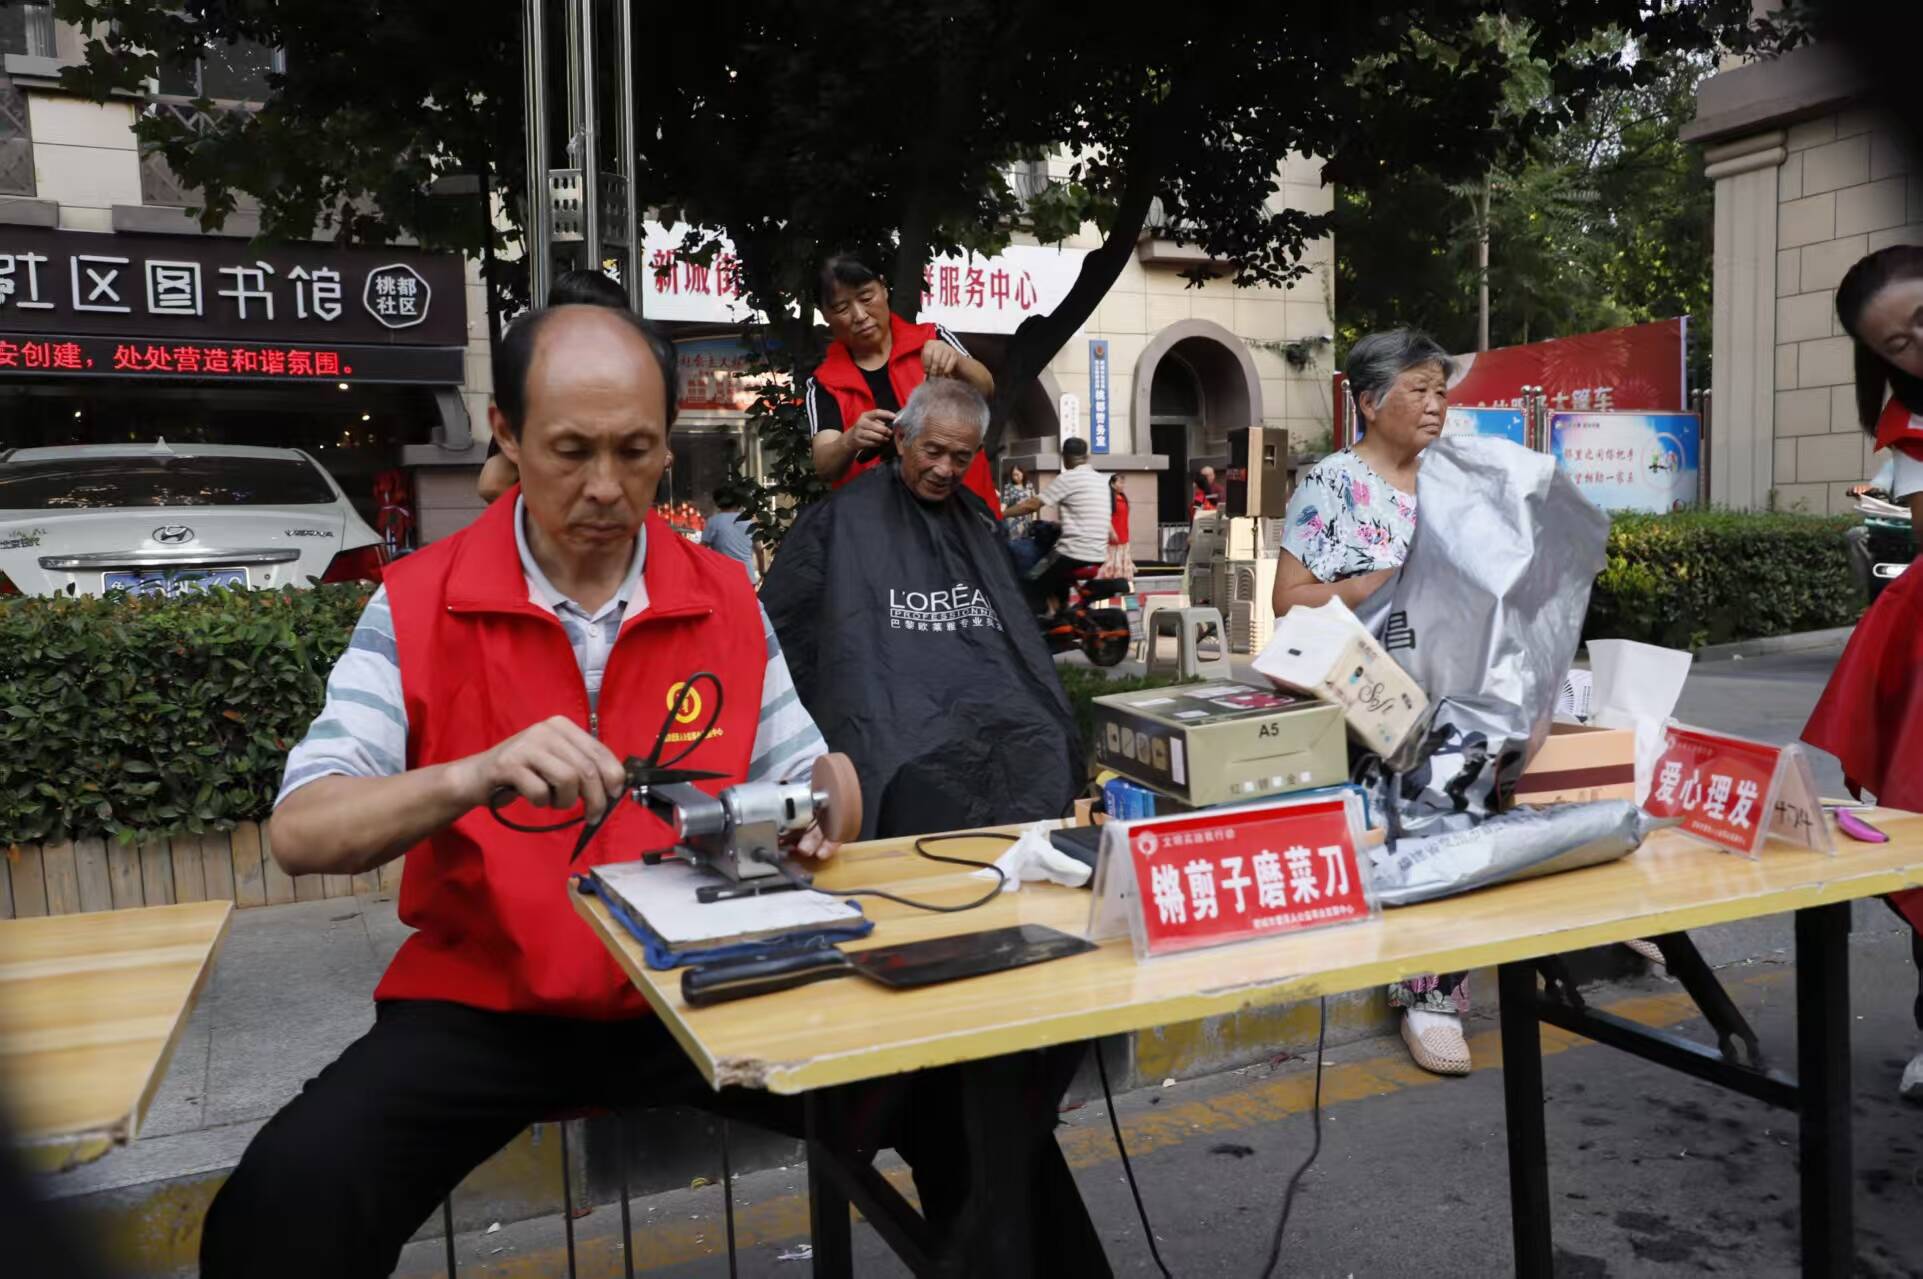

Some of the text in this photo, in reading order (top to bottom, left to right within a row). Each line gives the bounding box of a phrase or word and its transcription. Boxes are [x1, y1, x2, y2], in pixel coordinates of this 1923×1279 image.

[375, 275, 417, 295] 桃都
[376, 296, 418, 316] 社区
[1258, 722, 1279, 738] A5
[1655, 761, 1760, 829] 爱心理发
